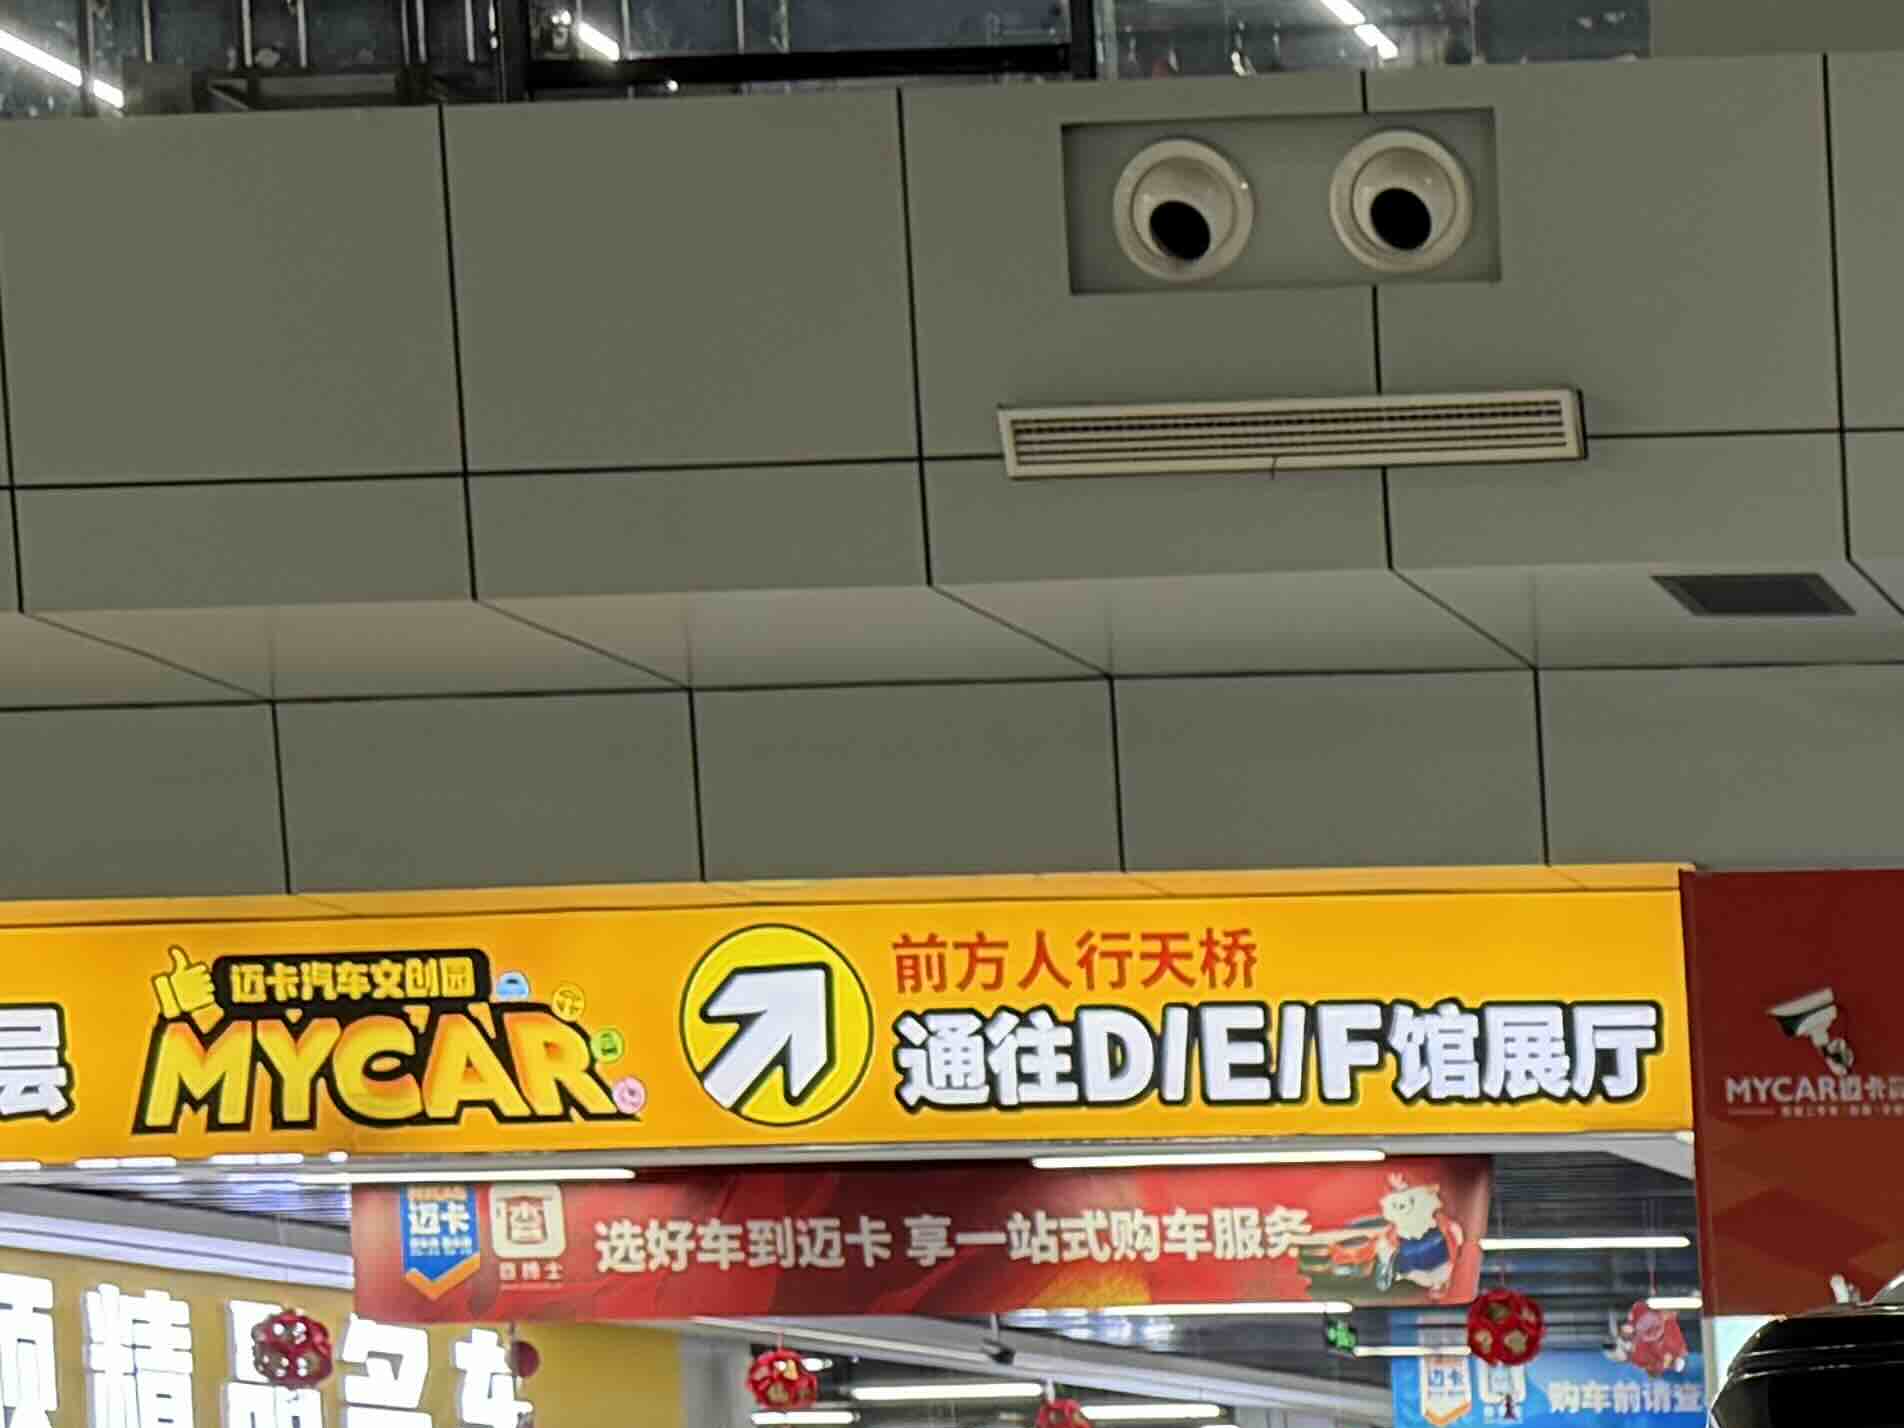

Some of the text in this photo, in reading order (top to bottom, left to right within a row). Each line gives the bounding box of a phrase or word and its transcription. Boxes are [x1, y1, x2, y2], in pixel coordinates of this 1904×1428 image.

[230, 955, 477, 1005] 迈卡汽车文创园
[892, 927, 1258, 994] 前方人行天桥
[143, 1011, 618, 1131] MYCAR
[895, 1003, 1660, 1107] 通往D/E/F馆展厅
[595, 1214, 894, 1274] 选好车到迈卡
